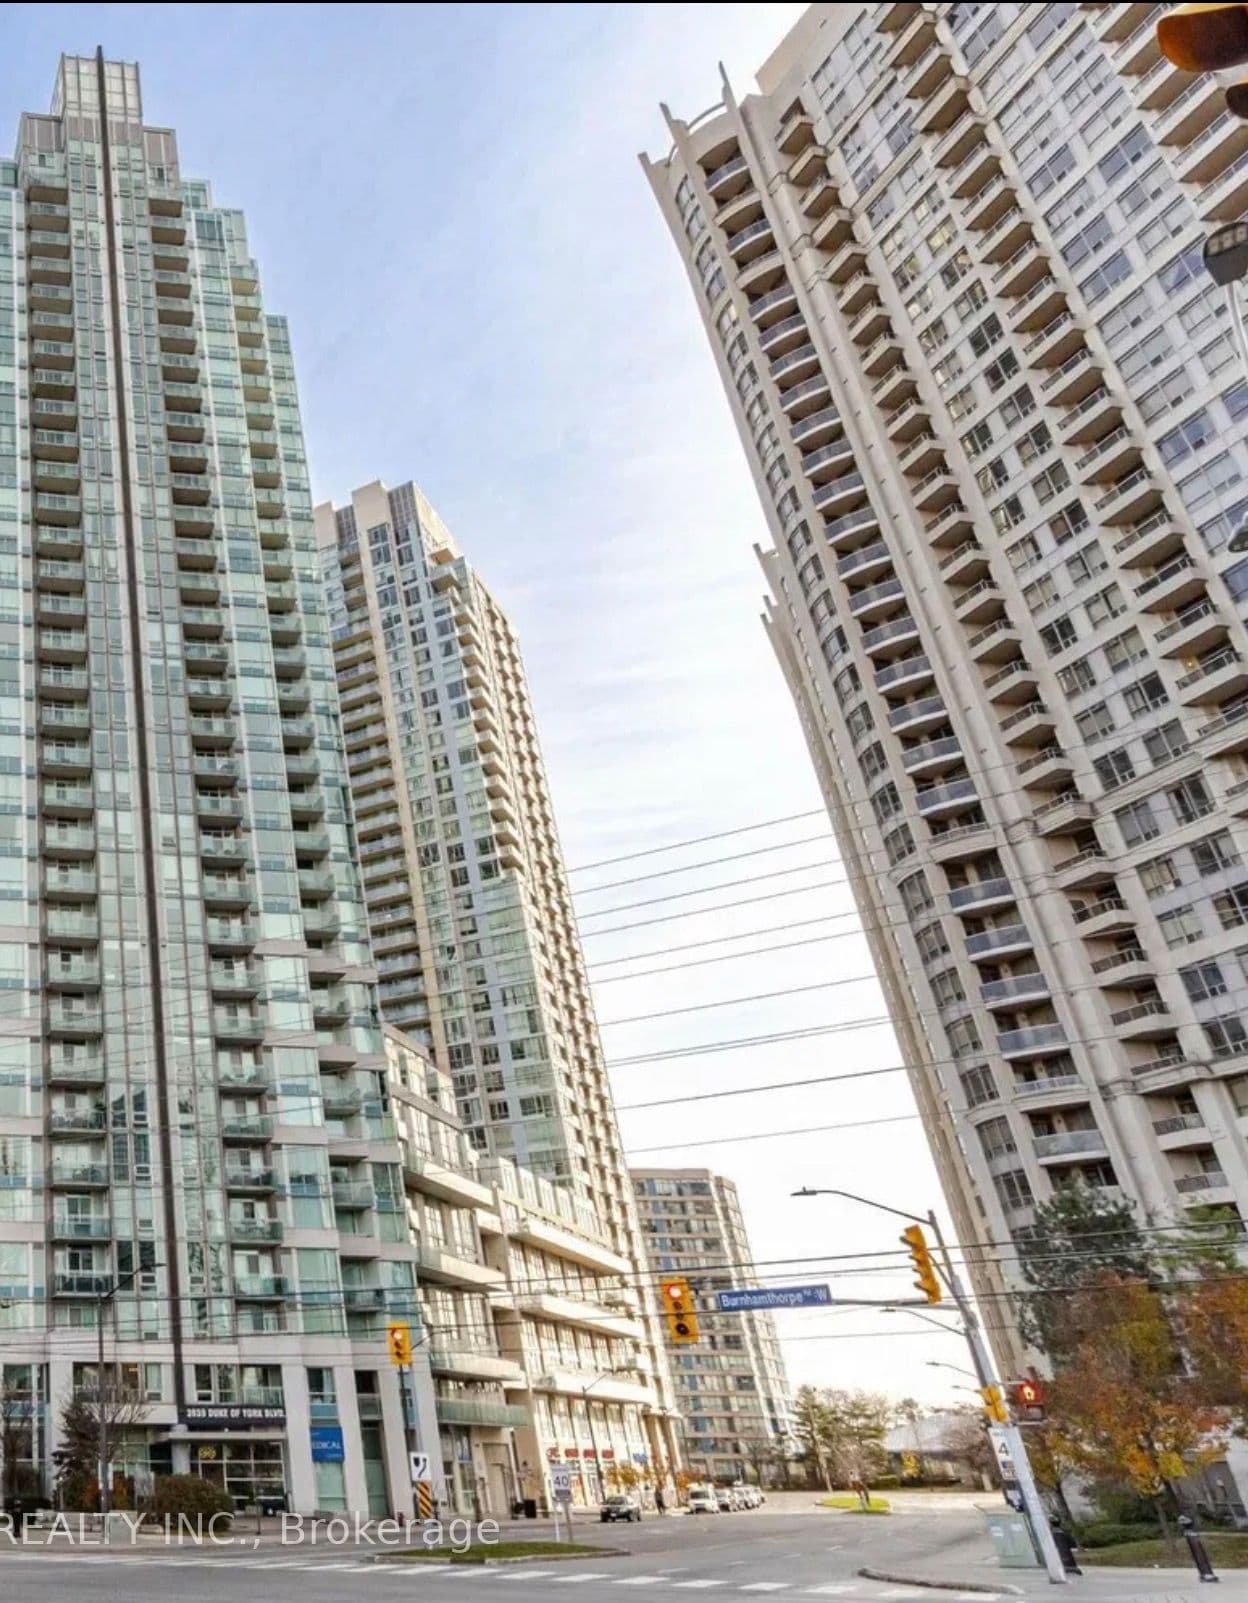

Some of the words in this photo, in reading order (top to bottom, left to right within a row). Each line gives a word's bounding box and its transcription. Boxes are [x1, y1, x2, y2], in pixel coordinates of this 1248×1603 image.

[720, 1290, 803, 1308] Burnhamthorpe
[208, 1407, 228, 1418] DUKE
[230, 1407, 240, 1418] OF
[242, 1407, 263, 1418] YORK
[553, 1475, 569, 1487] 40
